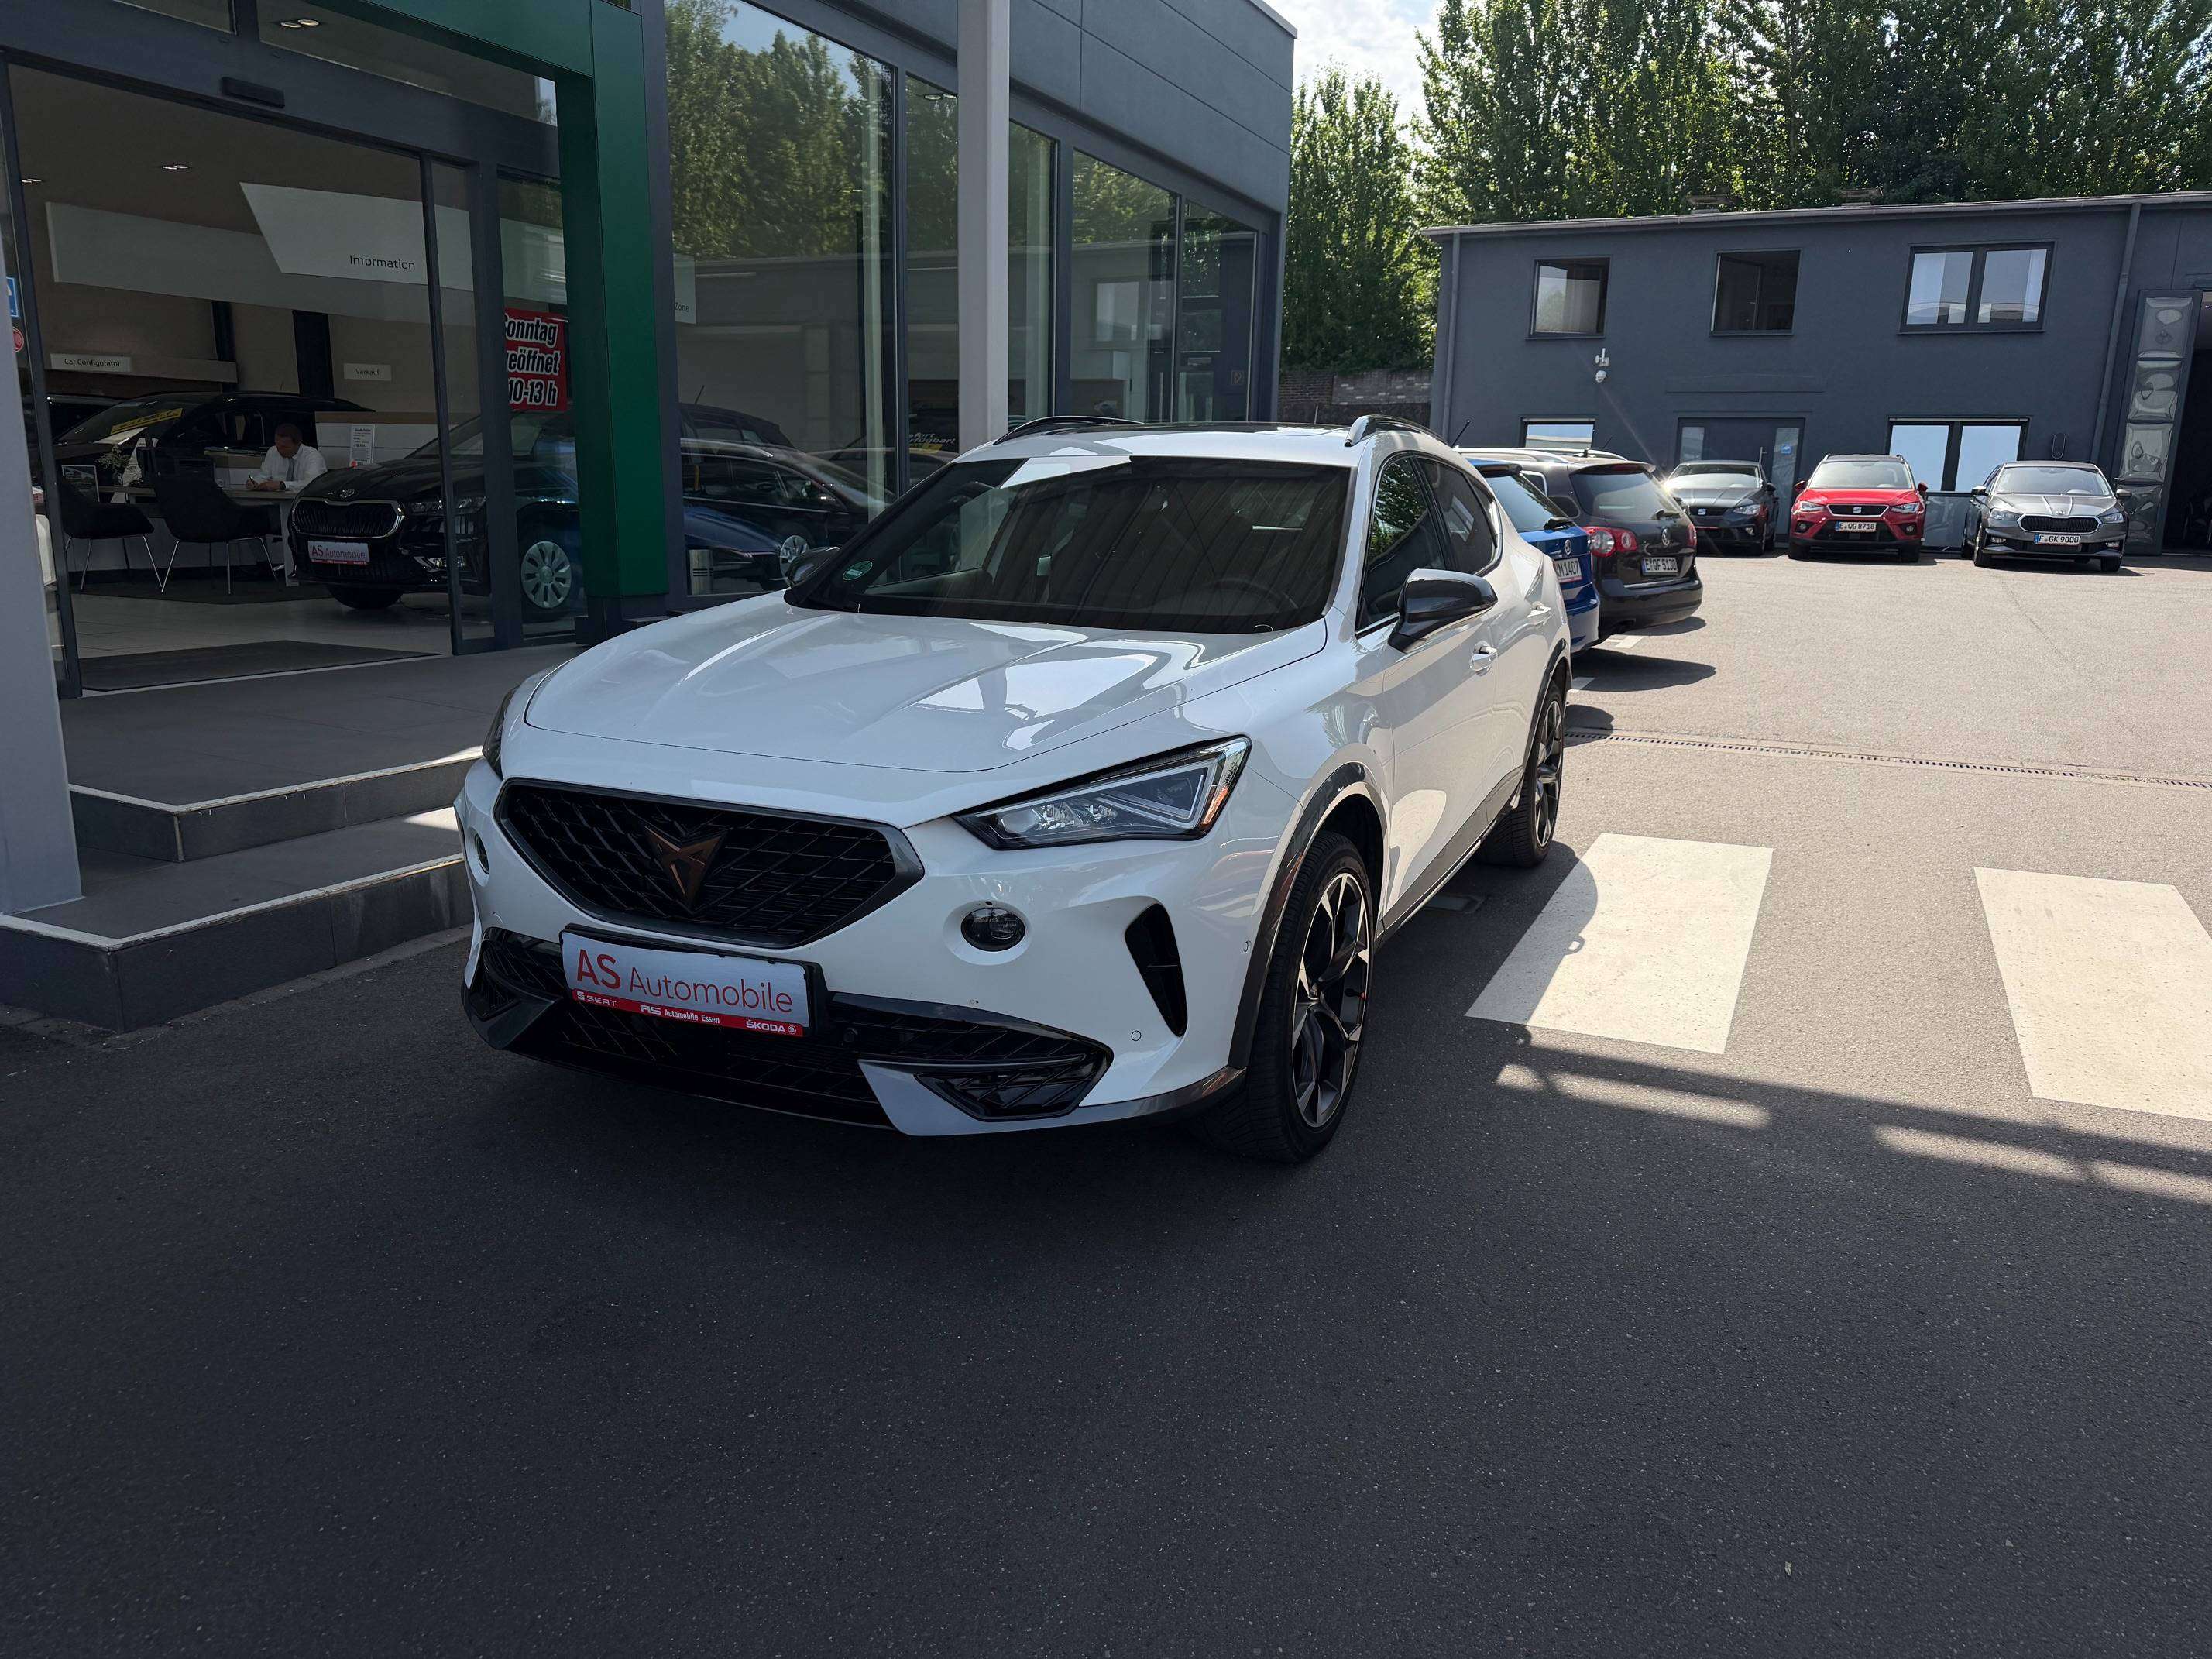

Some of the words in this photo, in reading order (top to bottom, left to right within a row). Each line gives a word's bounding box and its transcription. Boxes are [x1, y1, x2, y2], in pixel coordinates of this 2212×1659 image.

[349, 254, 416, 270] Information
[675, 302, 689, 312] Zone
[77, 359, 121, 368] Configurator
[507, 346, 560, 376] eöffnet
[508, 377, 545, 406] 10-13
[545, 380, 558, 406] h
[311, 544, 324, 557] AS
[325, 548, 366, 558] Automobile
[576, 948, 621, 990] AS
[630, 967, 792, 1013] Automobile
[586, 995, 617, 1006] SEAT
[640, 1005, 661, 1015] AS
[664, 1009, 699, 1021] Automobile
[701, 1014, 720, 1024] Essen
[746, 1019, 786, 1032] ŠKODA
